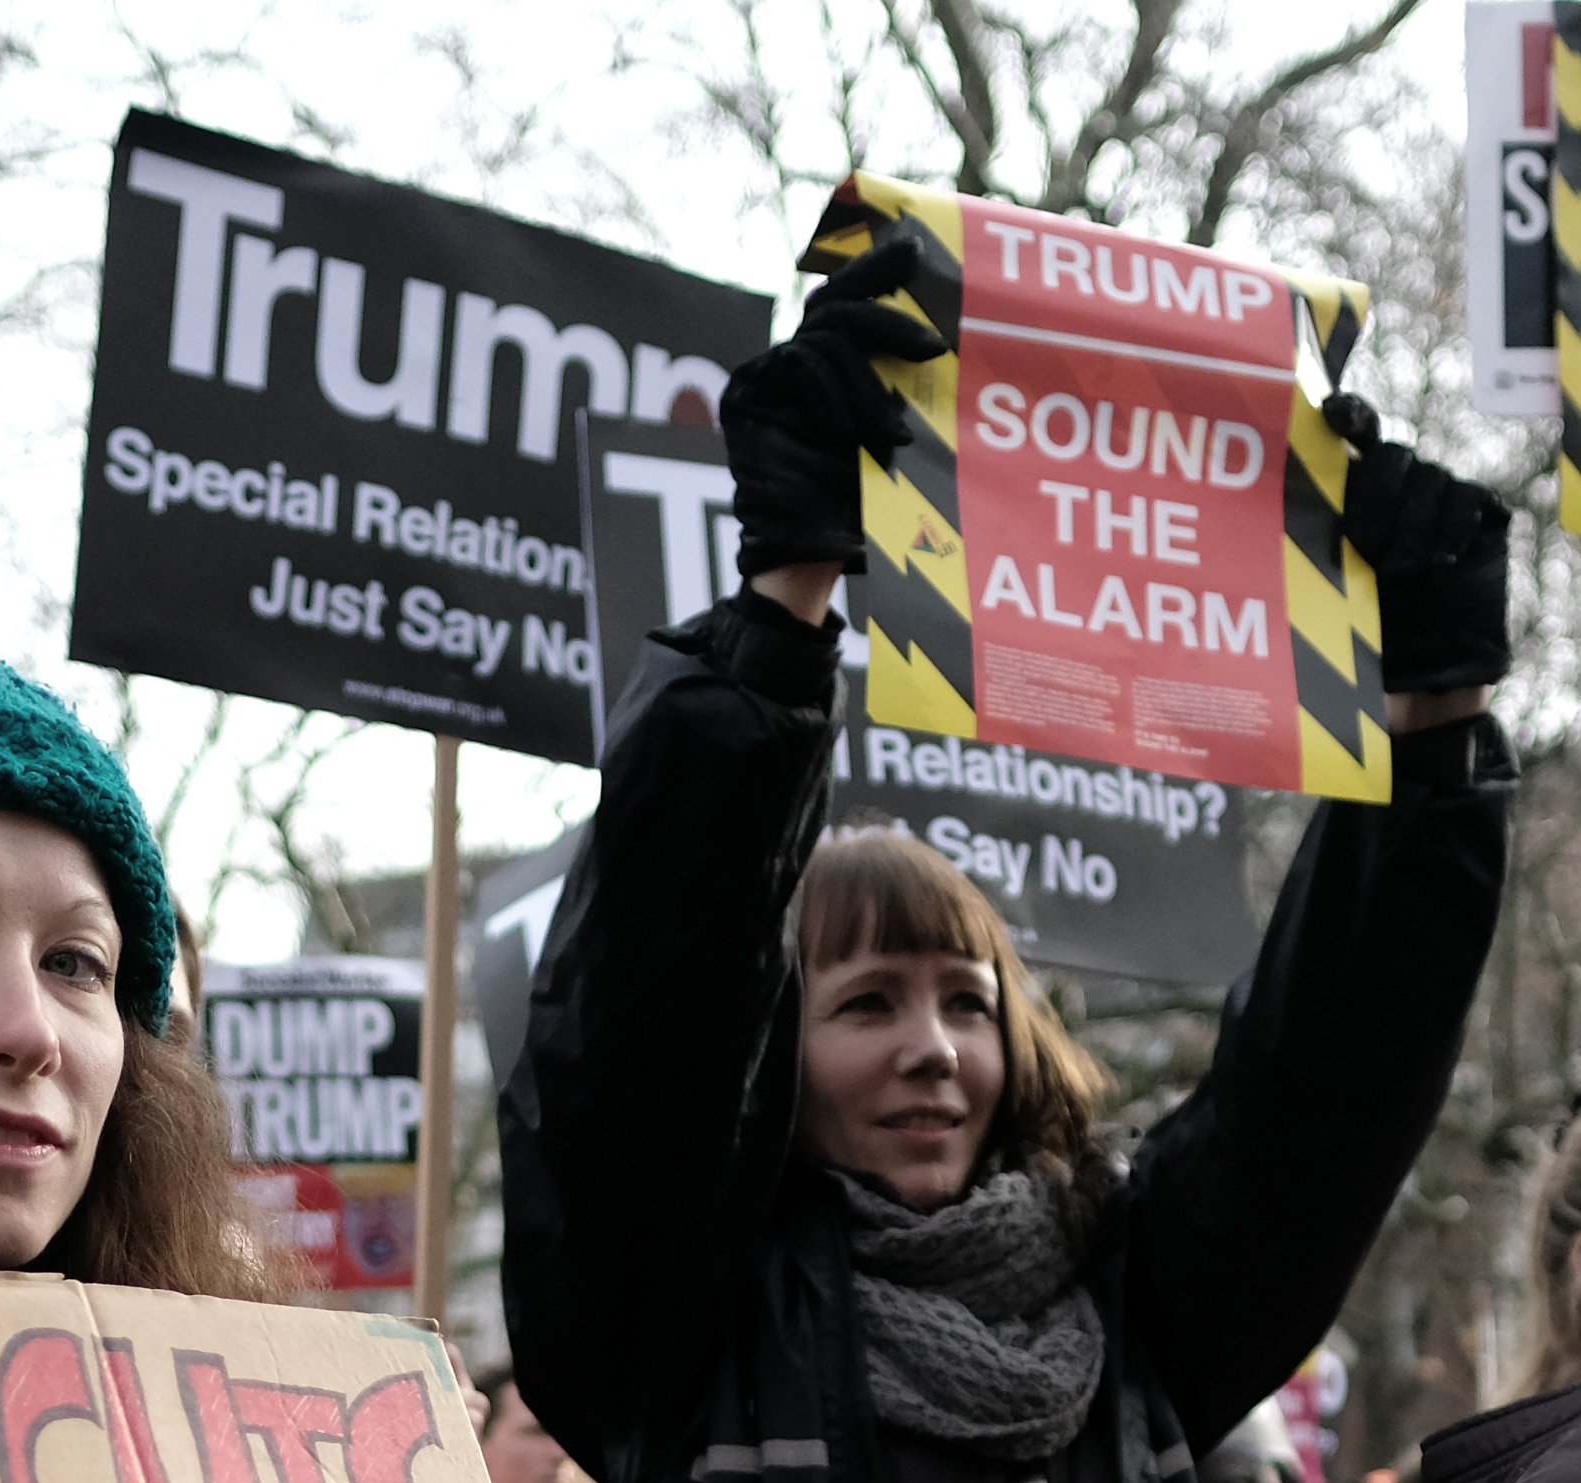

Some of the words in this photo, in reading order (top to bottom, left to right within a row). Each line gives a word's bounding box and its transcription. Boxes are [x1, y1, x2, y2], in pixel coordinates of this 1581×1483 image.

[984, 220, 1274, 322] TRUMP
[975, 383, 1264, 490] SOUND
[103, 425, 339, 537] Special
[351, 480, 590, 596] Relation
[1038, 480, 1201, 565] THE
[250, 557, 387, 640] Just
[396, 585, 513, 676] Say
[523, 615, 596, 685] No
[980, 554, 1270, 658] ALARM
[864, 724, 1229, 842] Relationship?
[925, 814, 1032, 899] Say
[1040, 833, 1118, 902] No
[211, 998, 395, 1078] DUMP
[221, 1076, 422, 1160] TRUMP
